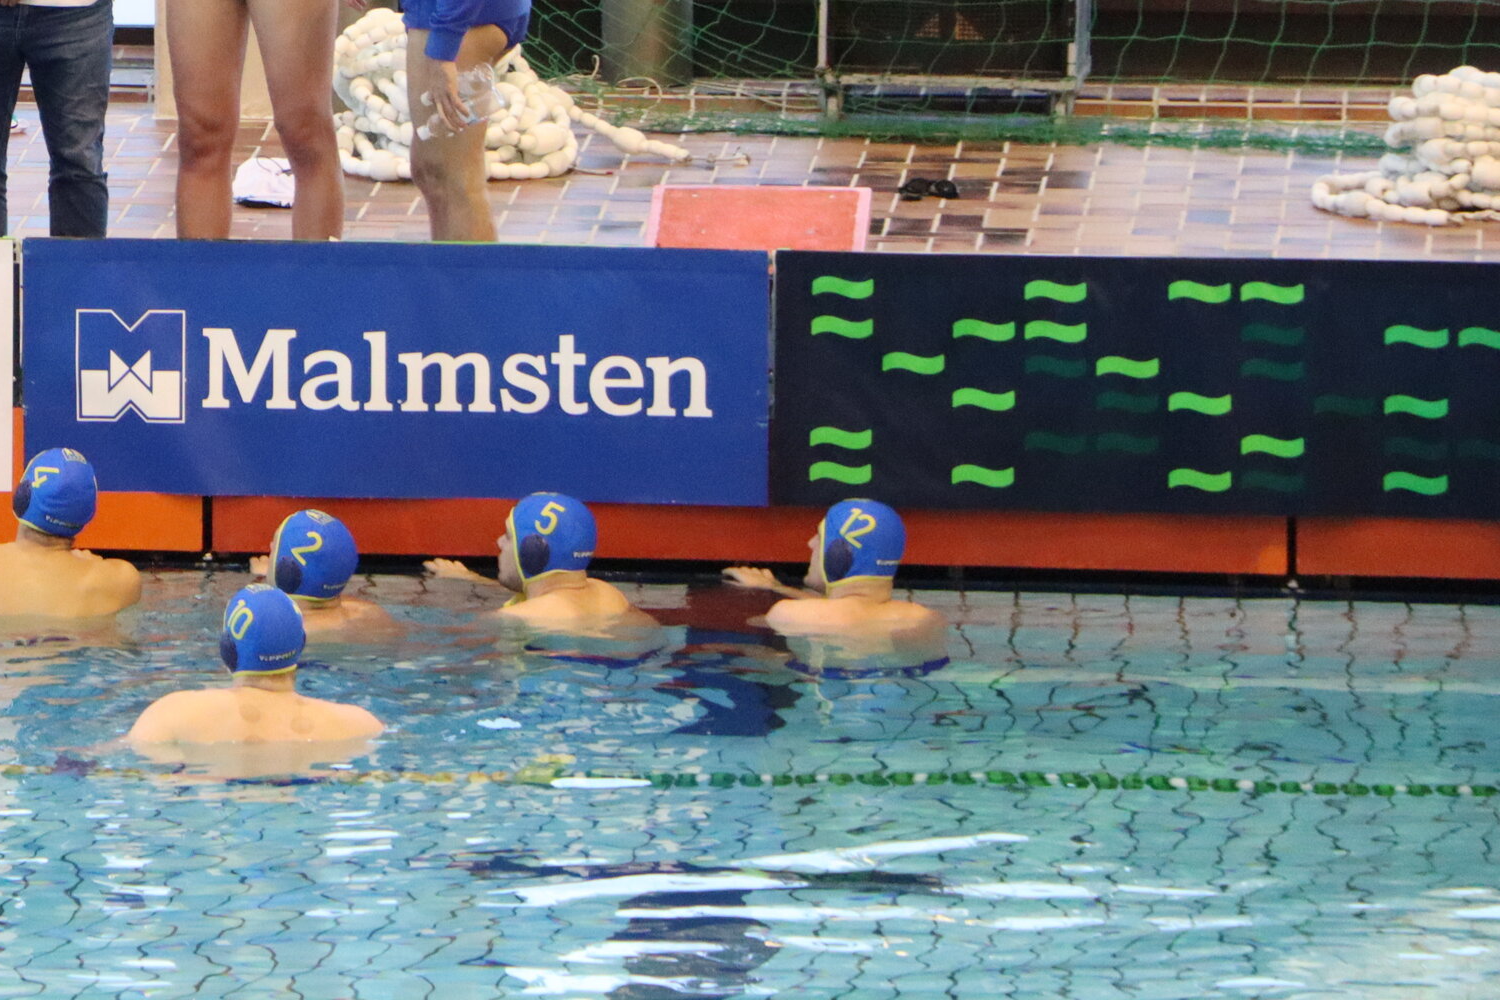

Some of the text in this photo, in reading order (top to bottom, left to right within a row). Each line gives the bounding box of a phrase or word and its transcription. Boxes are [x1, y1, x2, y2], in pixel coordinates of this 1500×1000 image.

[201, 328, 713, 418] Malmsten
[31, 466, 60, 489] 4
[534, 501, 565, 536] 5
[840, 508, 877, 549] 12
[291, 531, 323, 566] 2
[228, 599, 253, 640] 10
